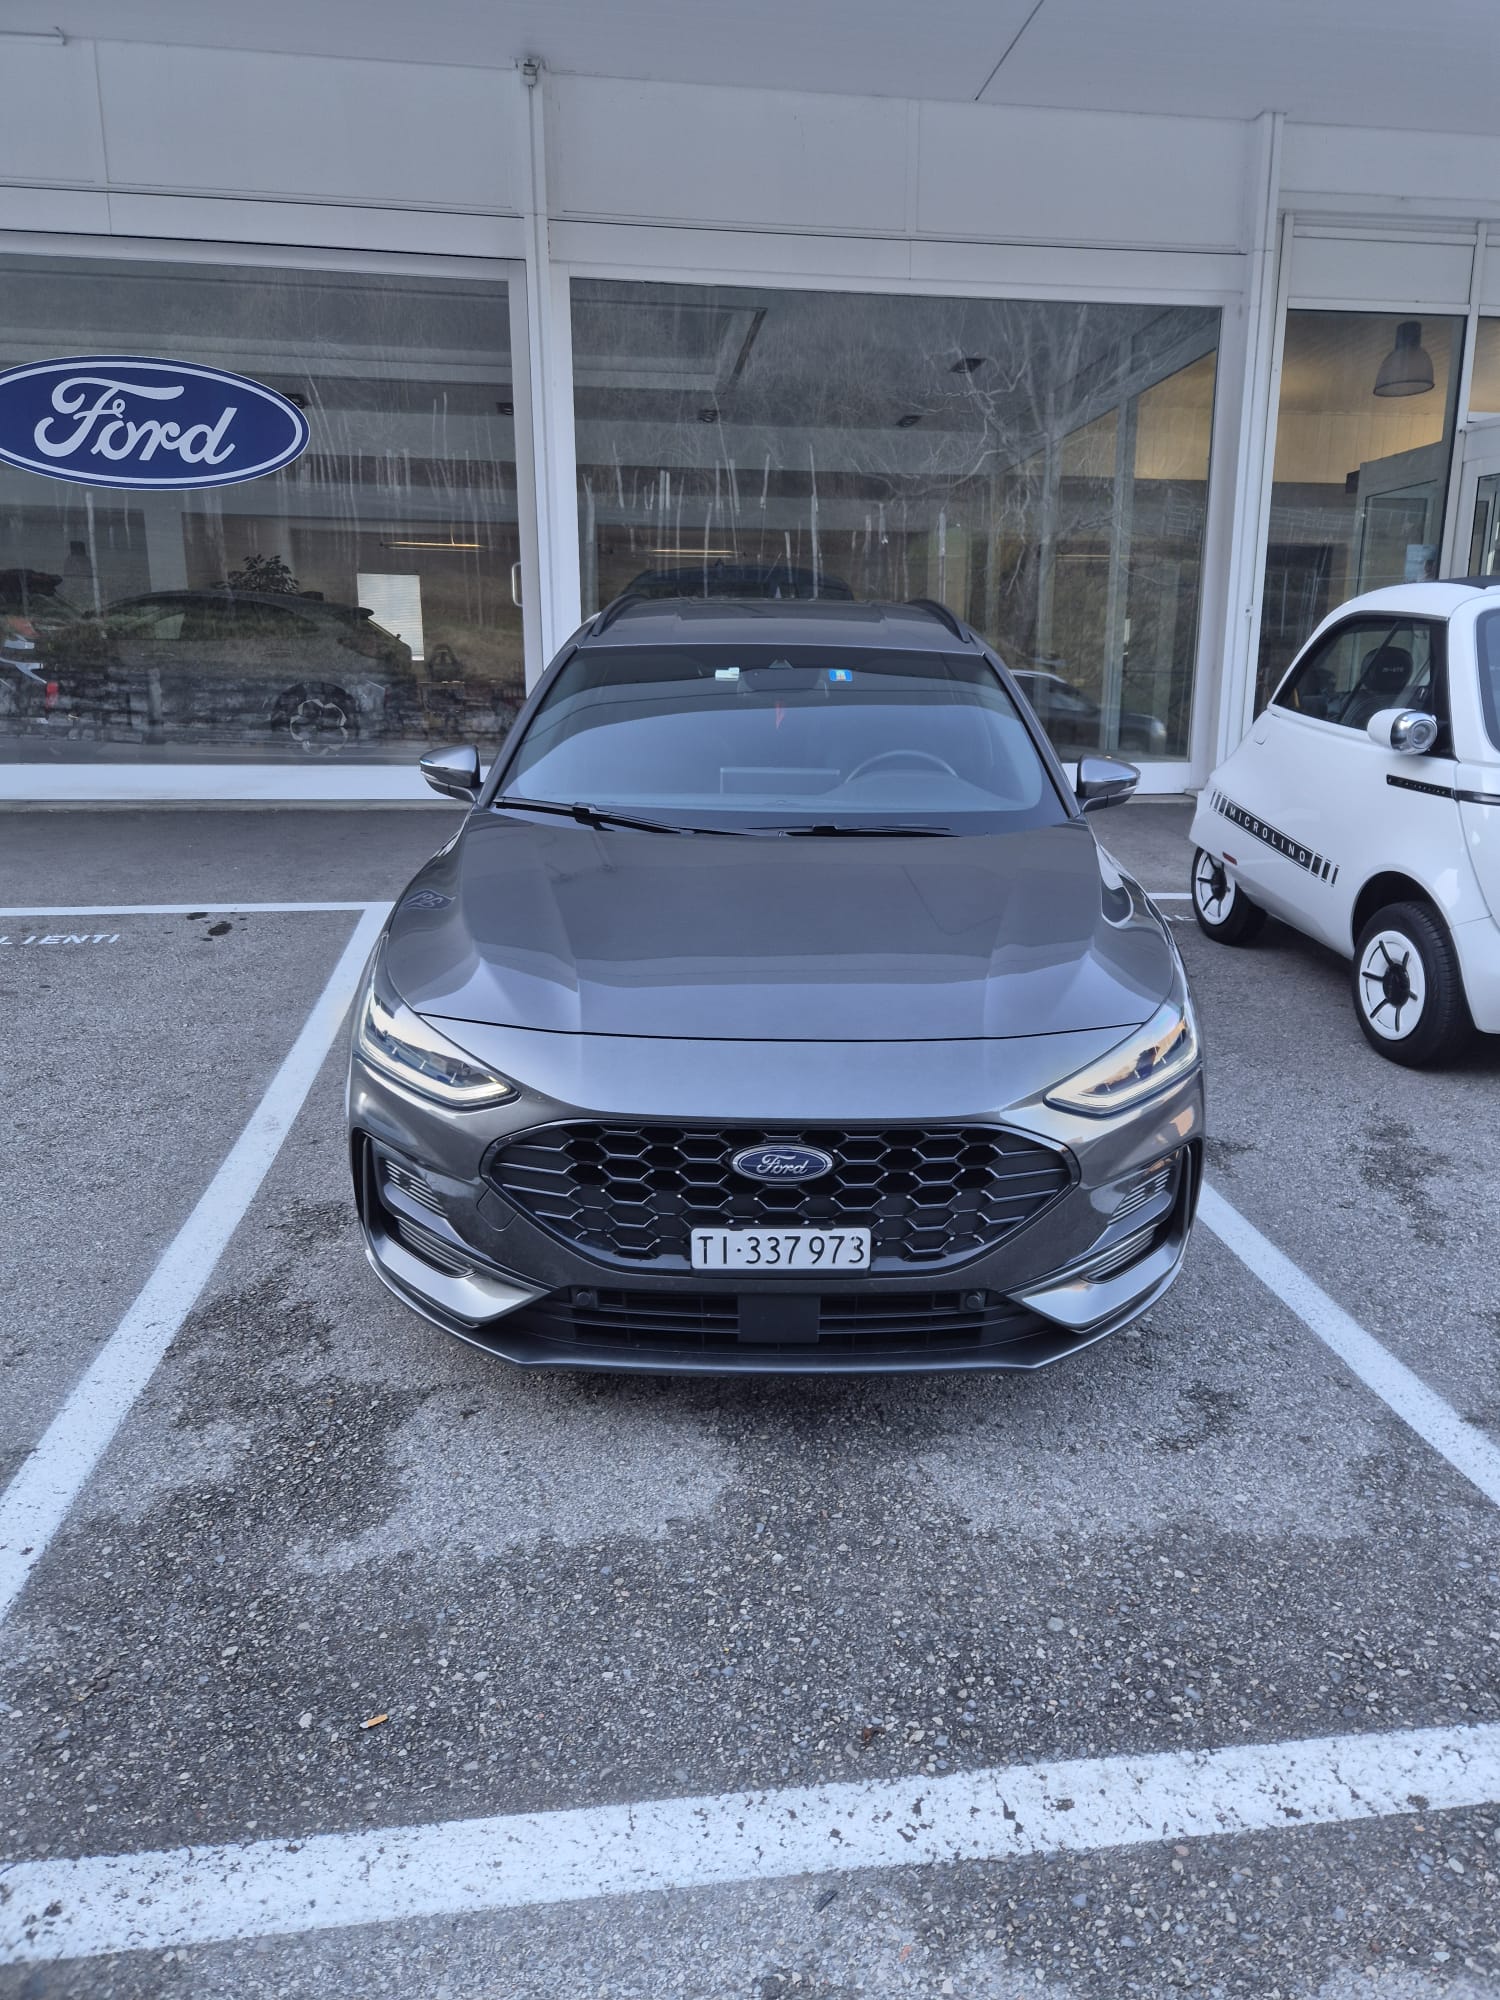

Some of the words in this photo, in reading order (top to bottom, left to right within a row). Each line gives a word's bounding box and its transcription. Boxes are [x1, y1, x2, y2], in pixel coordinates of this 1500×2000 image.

[33, 376, 239, 465] Ford
[1228, 807, 1306, 863] MICROLINO
[756, 1154, 808, 1175] Ford
